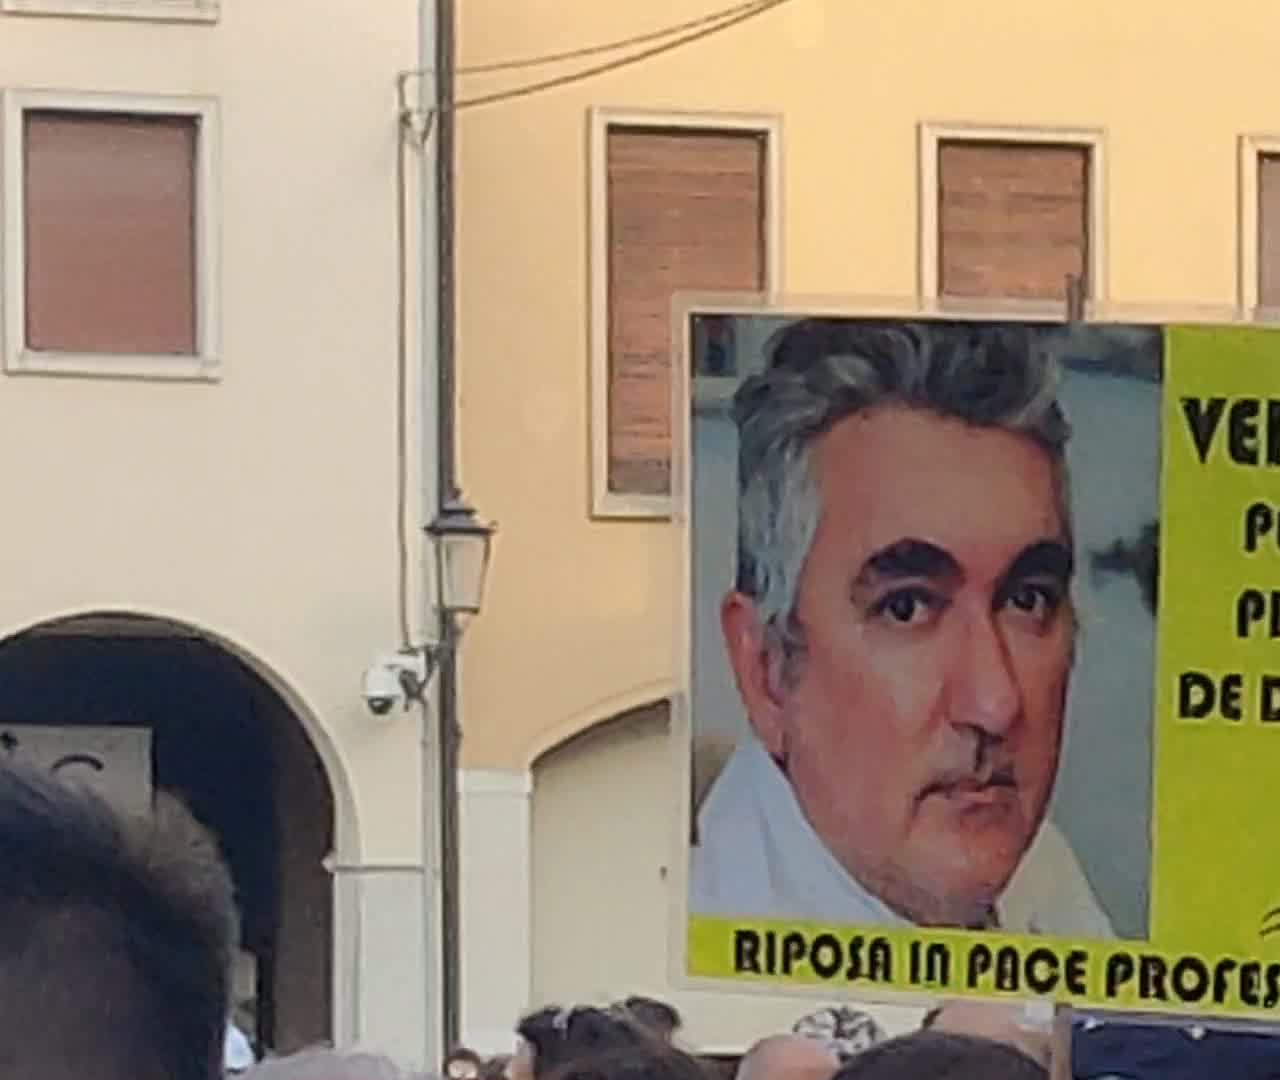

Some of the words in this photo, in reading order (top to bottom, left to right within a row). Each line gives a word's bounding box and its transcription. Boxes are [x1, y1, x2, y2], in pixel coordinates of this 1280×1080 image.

[1176, 670, 1244, 722] DE
[732, 928, 894, 984] RIPOSA
[907, 938, 952, 988] IN
[965, 942, 1090, 997] PACE
